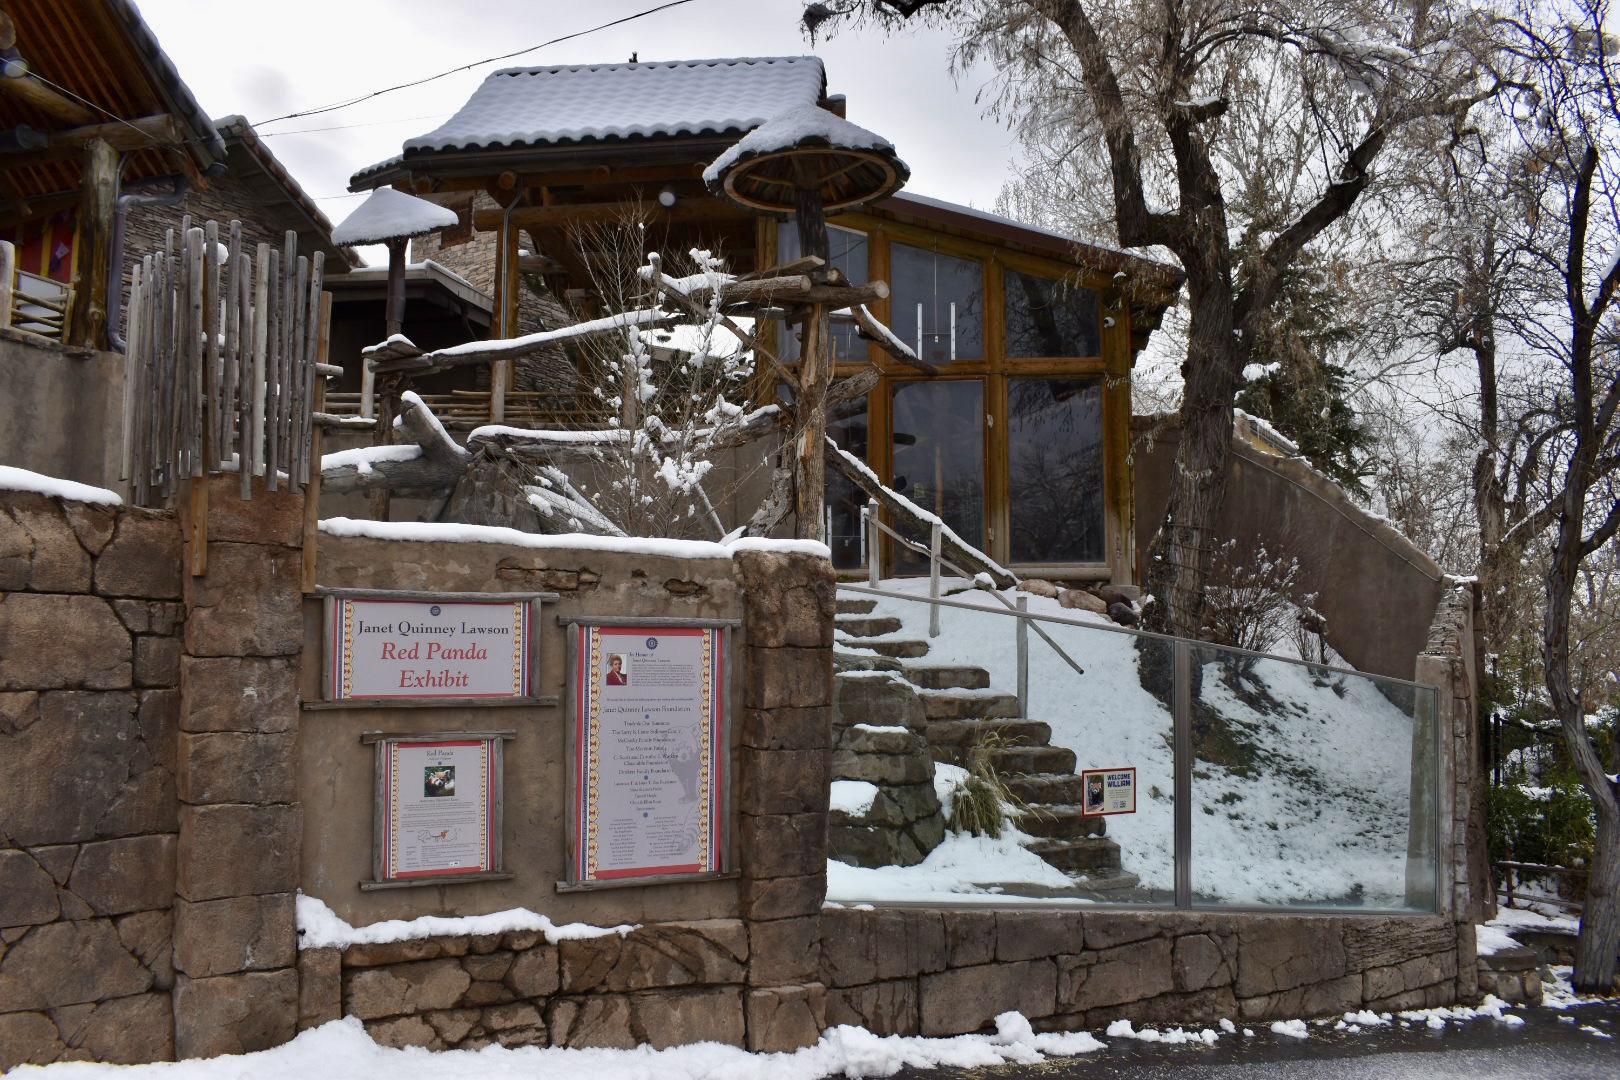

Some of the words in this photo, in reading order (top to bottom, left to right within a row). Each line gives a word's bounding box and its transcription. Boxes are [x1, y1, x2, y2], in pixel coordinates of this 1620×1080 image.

[357, 620, 393, 636] Janet
[398, 620, 456, 637] Quinney
[461, 621, 509, 635] Lawson
[380, 641, 420, 660] Red
[426, 641, 488, 660] Panda
[398, 669, 470, 688] Exhibit
[1107, 780, 1131, 788] WILLIAM
